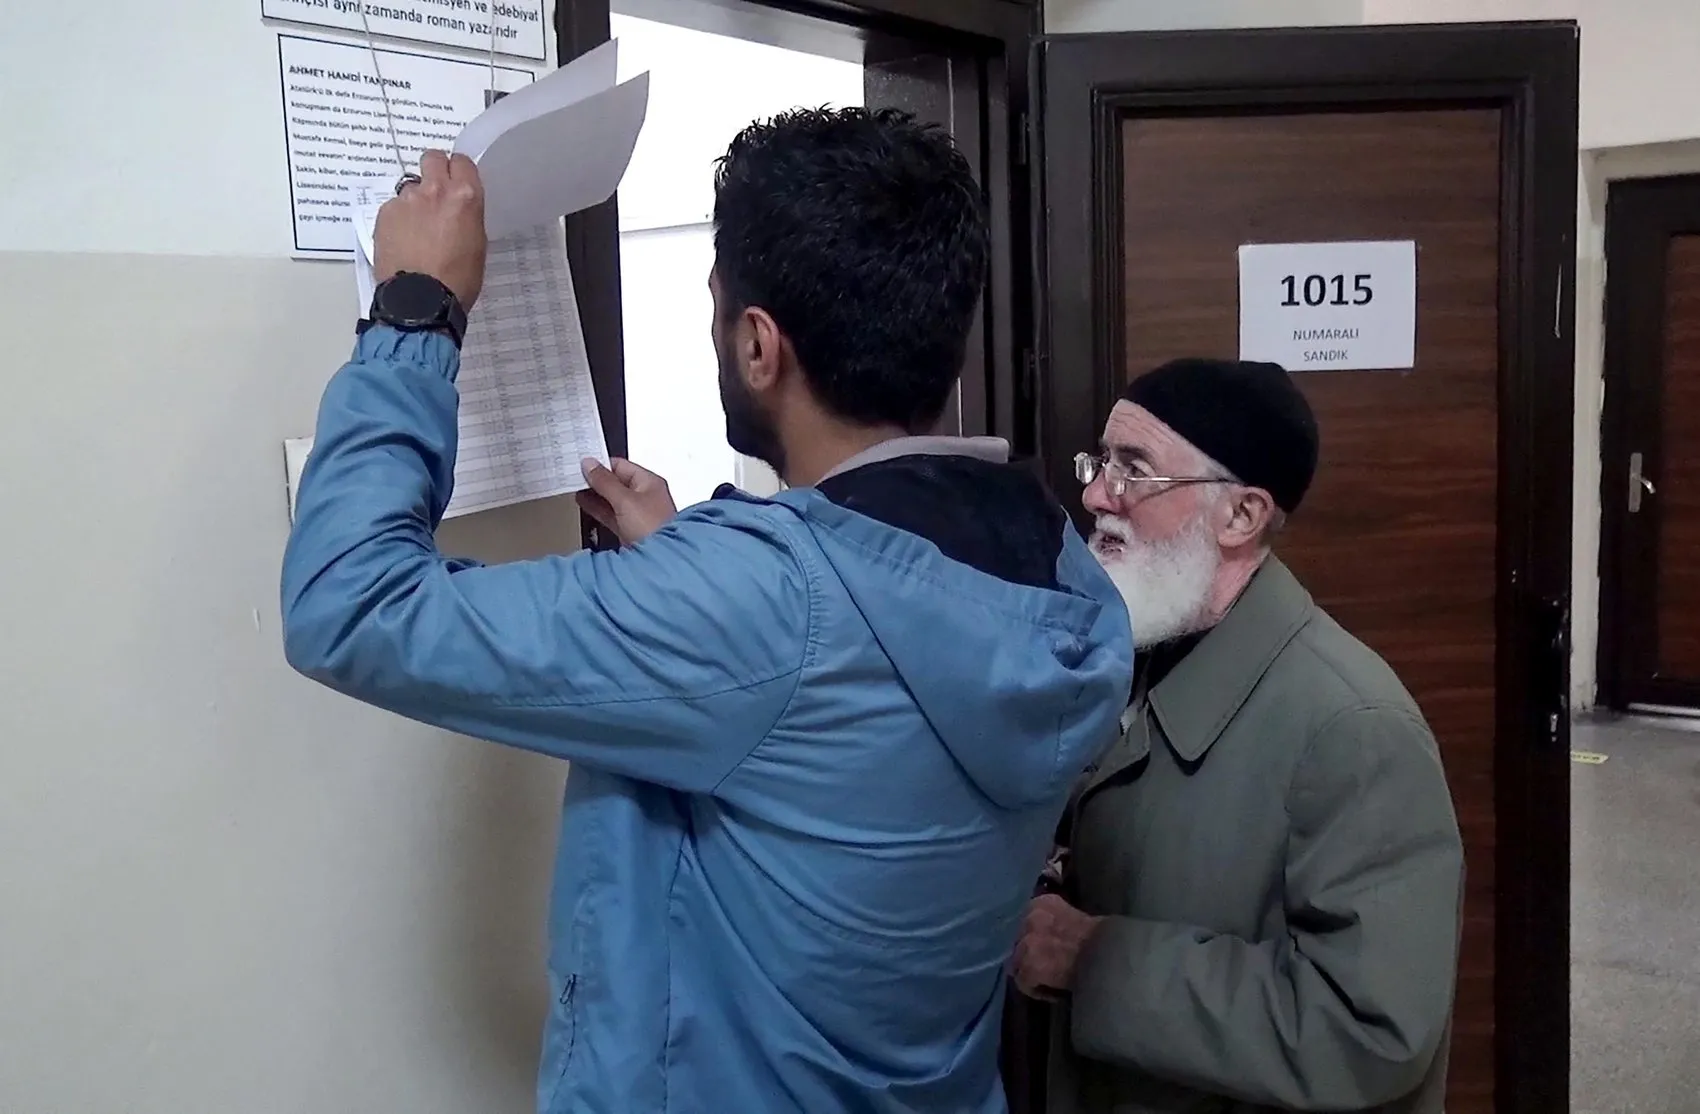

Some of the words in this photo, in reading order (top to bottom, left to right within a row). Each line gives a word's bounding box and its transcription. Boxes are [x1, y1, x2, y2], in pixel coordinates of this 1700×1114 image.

[474, 1, 488, 13] ve
[365, 4, 423, 23] zamanda
[427, 15, 466, 30] roman
[289, 65, 325, 78] AHMET
[328, 70, 362, 83] HAMDİ
[1281, 274, 1373, 307] 1015
[1293, 328, 1359, 341] NUMARALI
[1303, 349, 1348, 362] SANDIK
